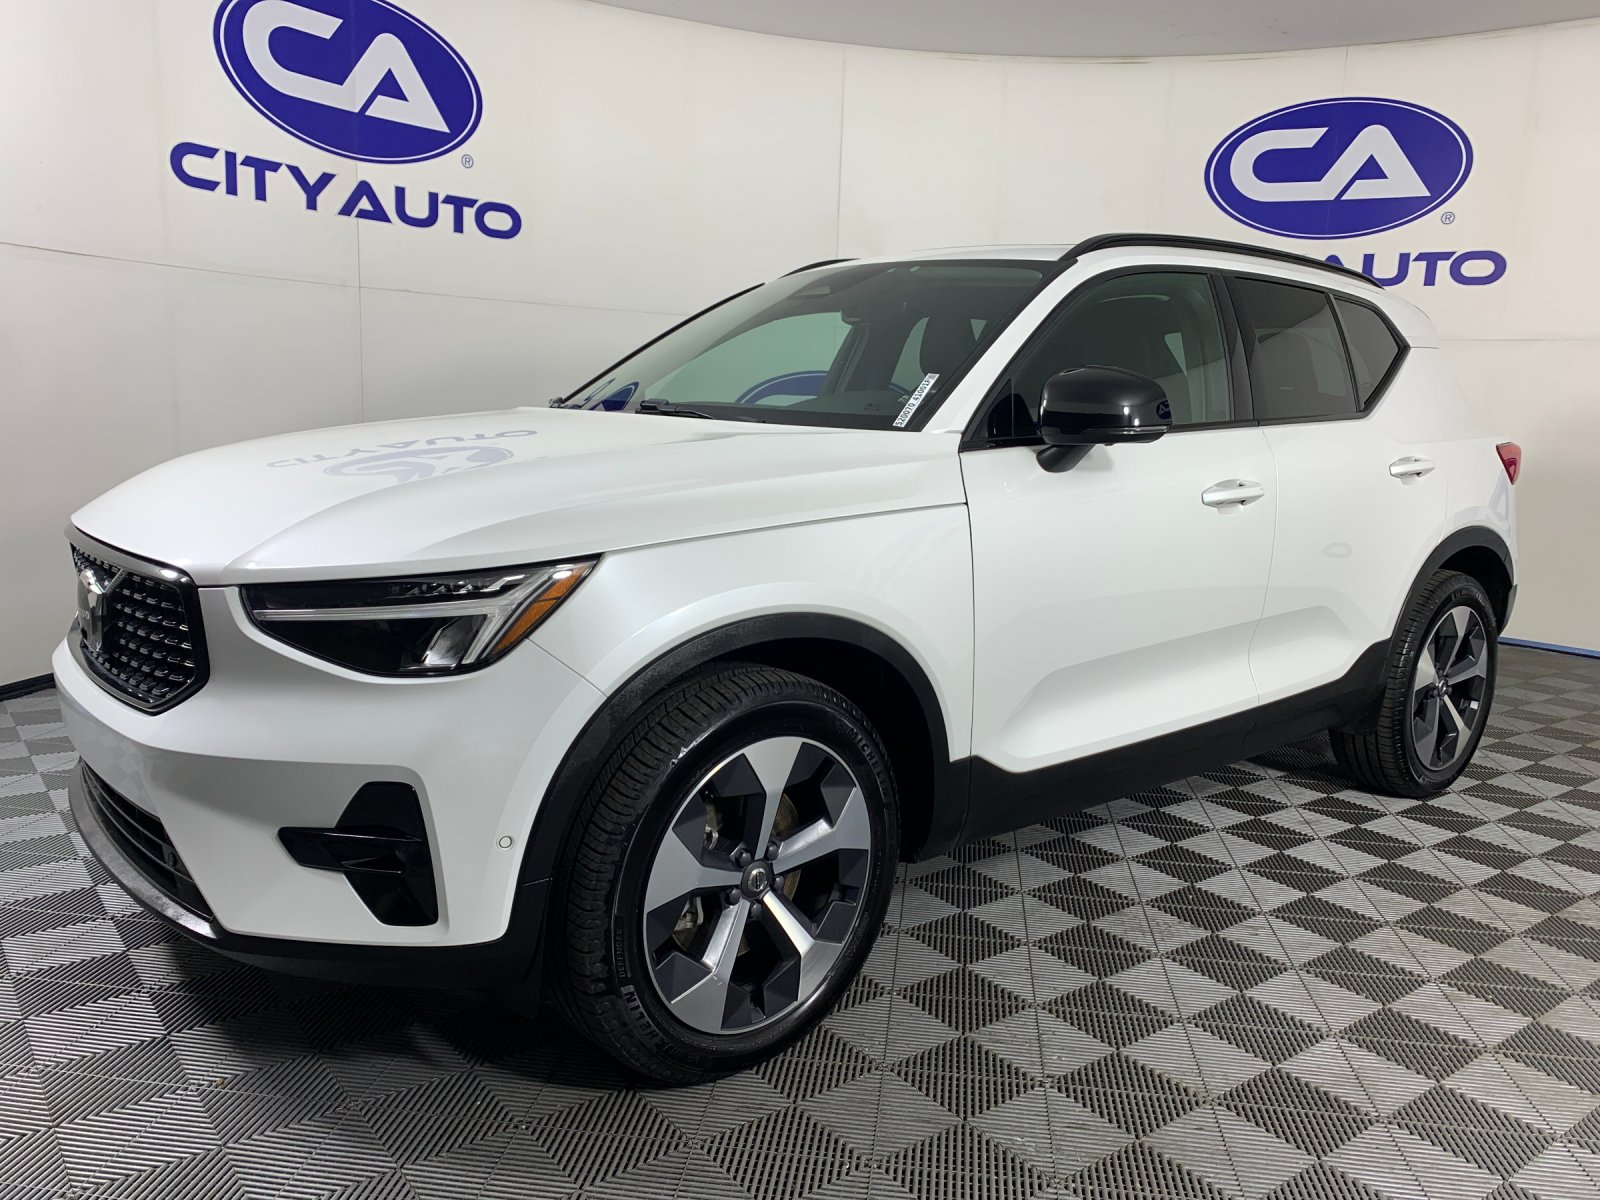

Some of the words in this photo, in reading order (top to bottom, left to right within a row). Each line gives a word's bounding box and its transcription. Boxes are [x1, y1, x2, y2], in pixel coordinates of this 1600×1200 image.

[242, 0, 451, 134] CA
[1229, 123, 1432, 203] CA
[1323, 249, 1507, 287] UTO
